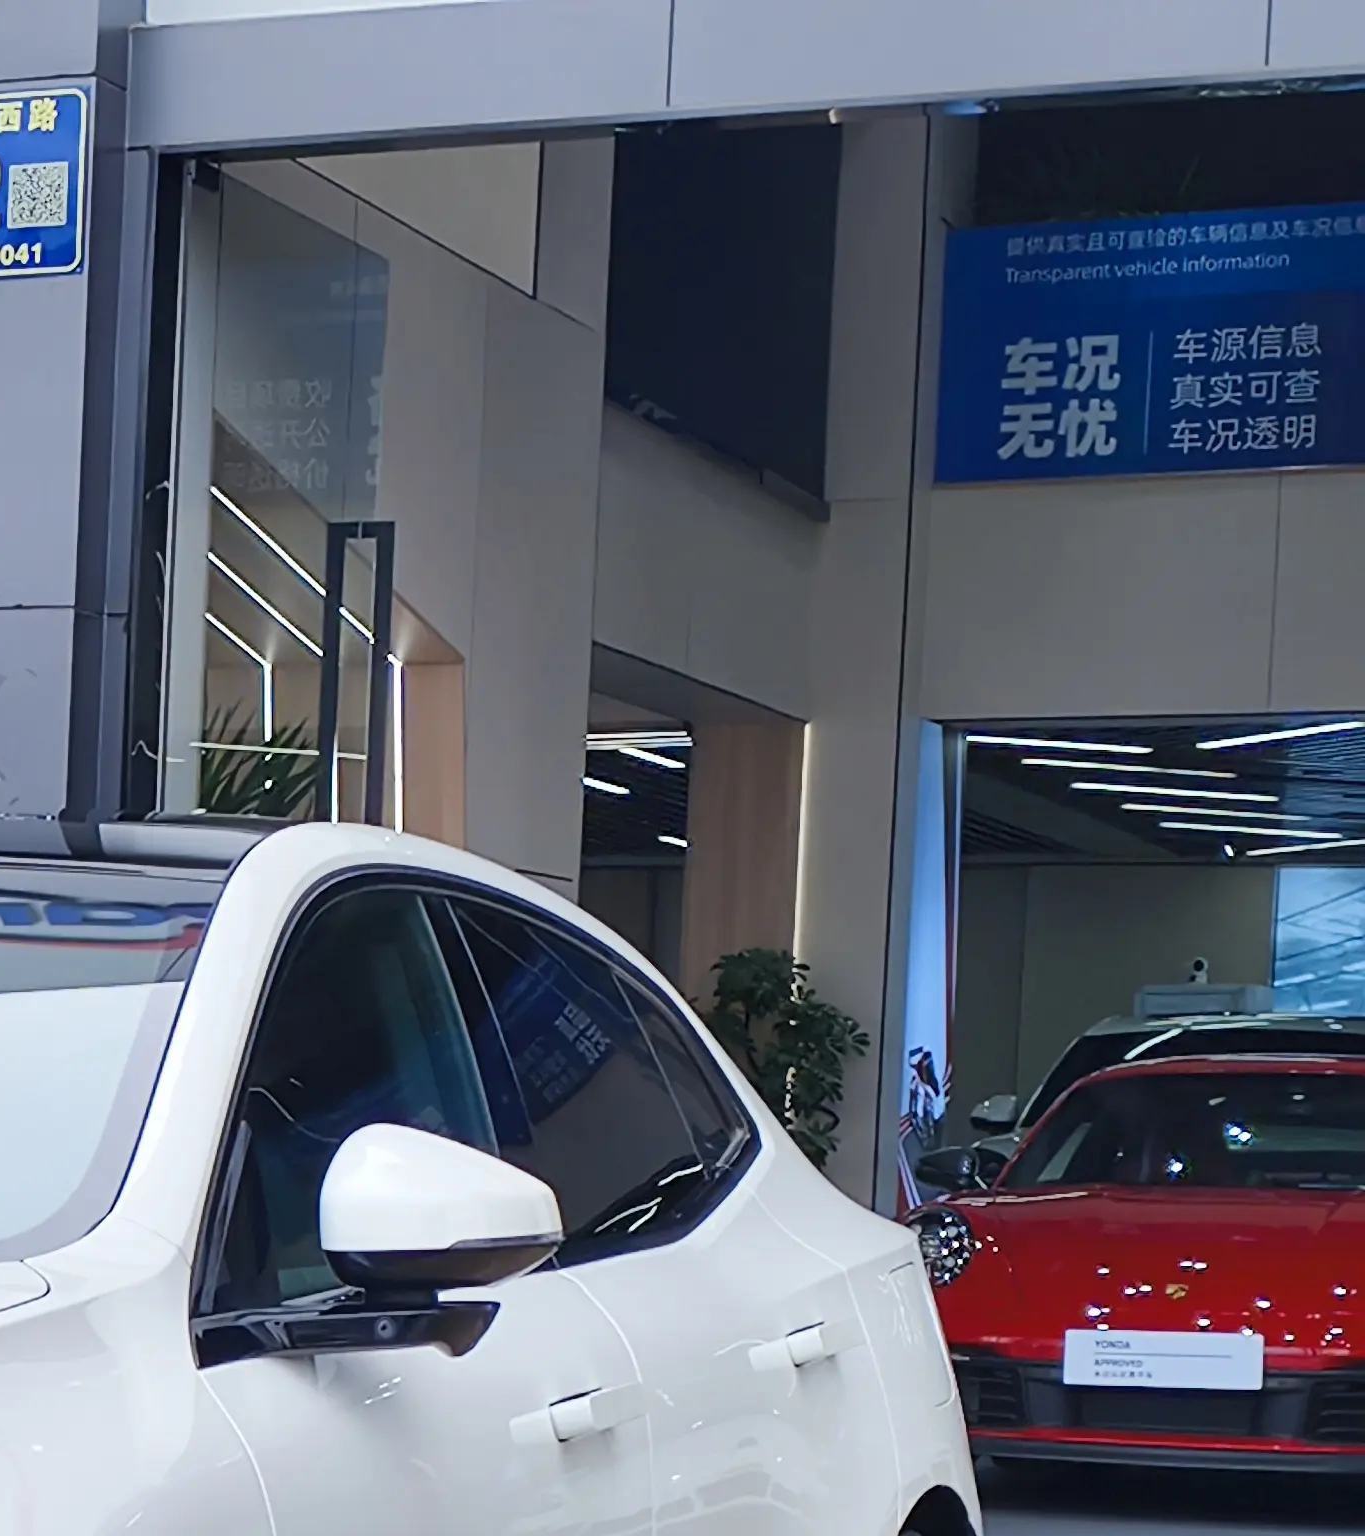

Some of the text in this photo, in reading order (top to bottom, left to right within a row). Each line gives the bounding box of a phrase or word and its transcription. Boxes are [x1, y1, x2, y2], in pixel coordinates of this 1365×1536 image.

[1005, 262, 1111, 284] Transparent
[1115, 257, 1178, 277] vehicle
[1173, 323, 1323, 364] 车源信息
[1001, 334, 1121, 395] 车况
[1170, 368, 1322, 409] 真实可查
[997, 398, 1119, 460] 无忧
[1168, 414, 1318, 454] 车况透明
